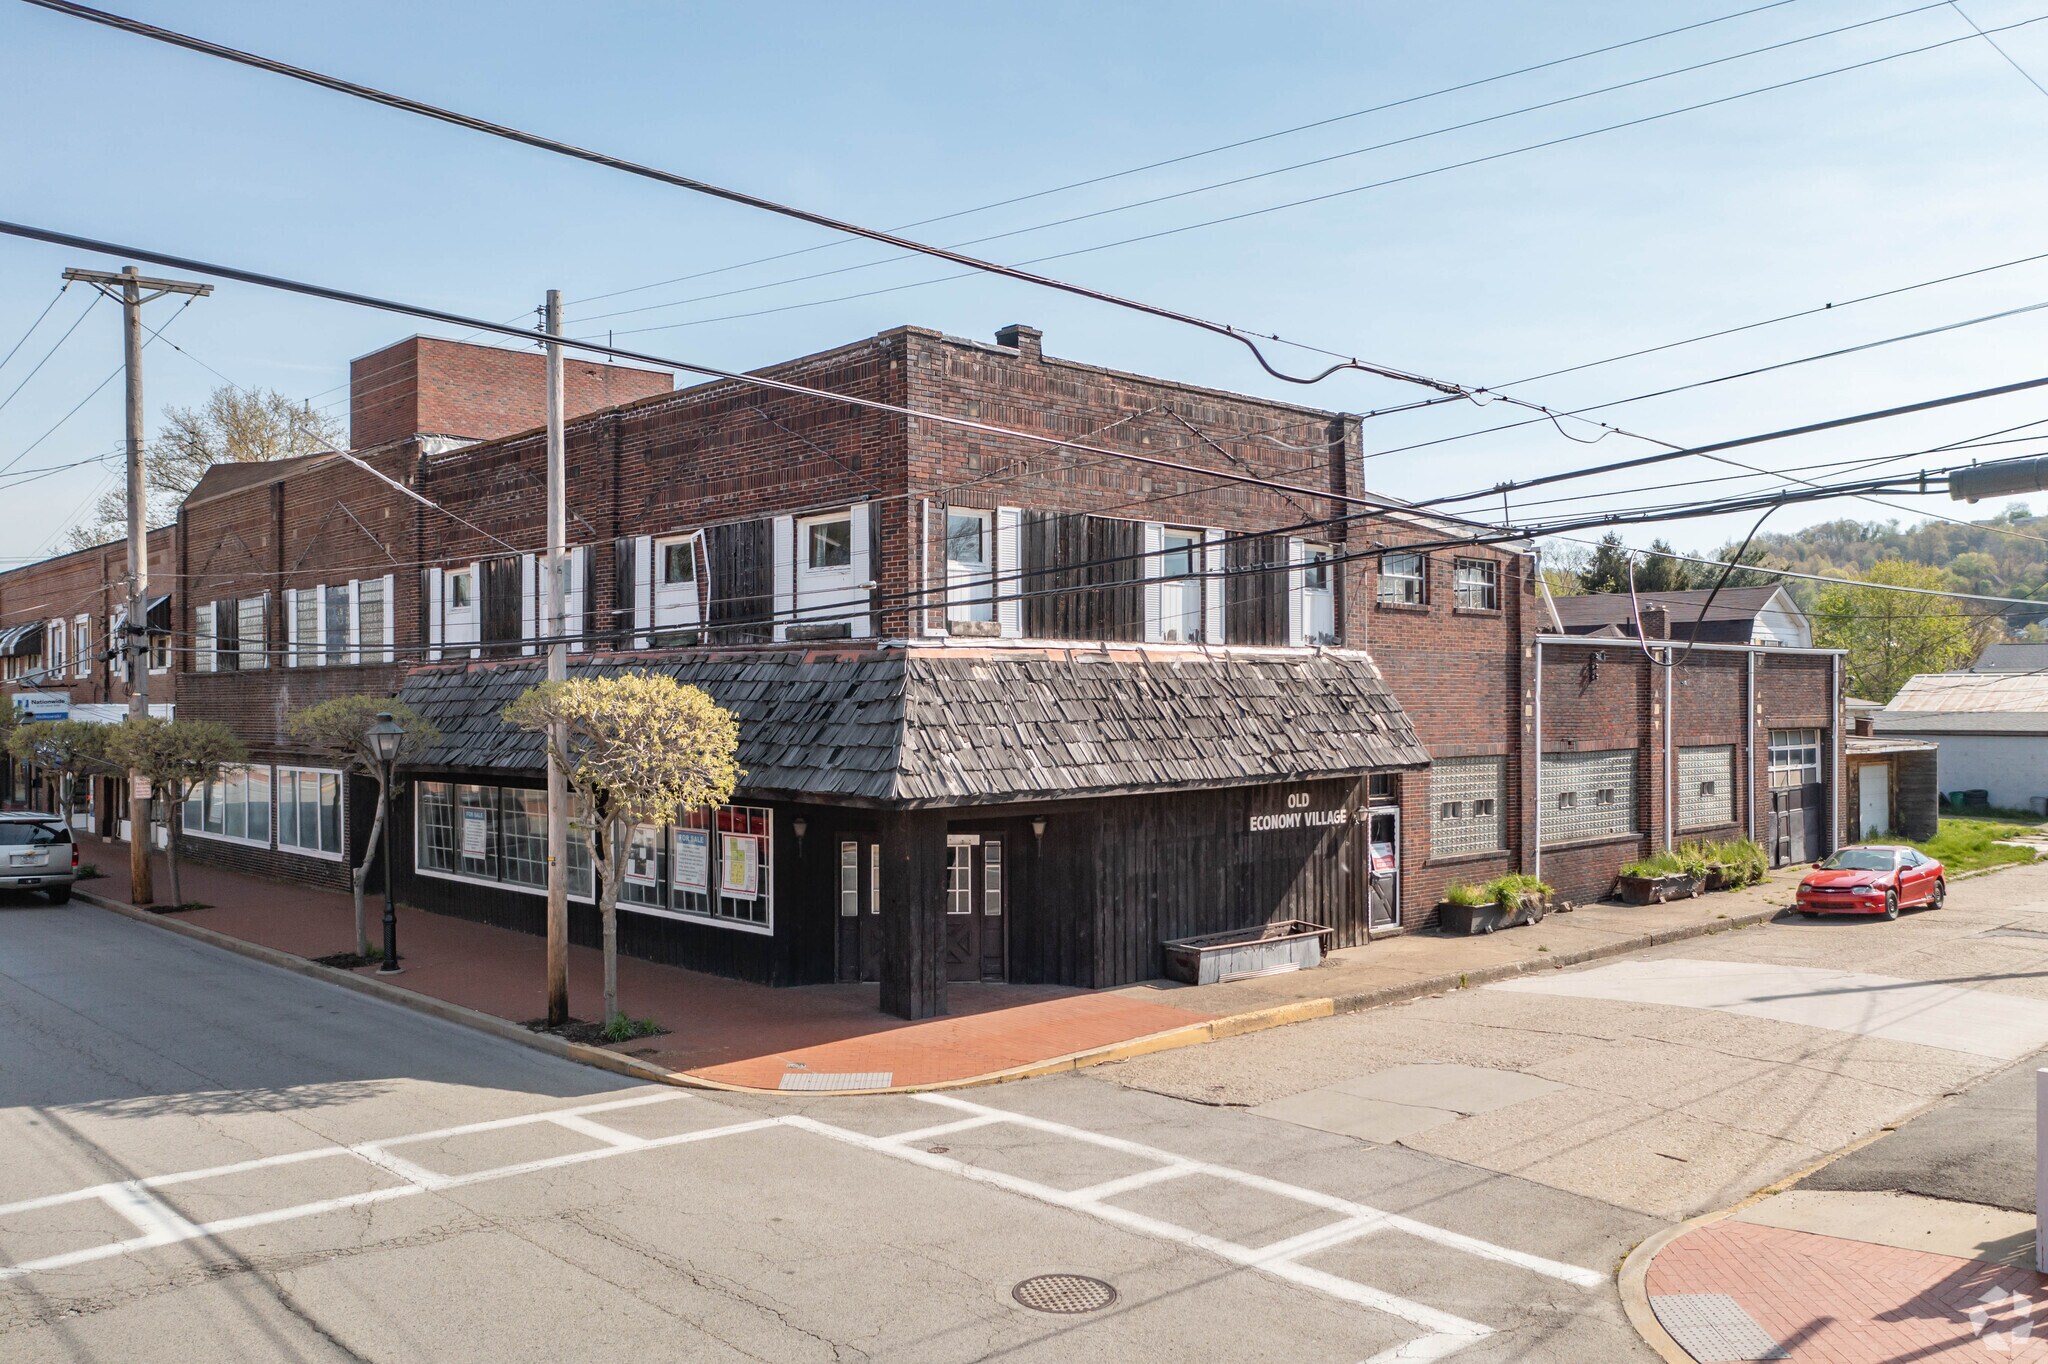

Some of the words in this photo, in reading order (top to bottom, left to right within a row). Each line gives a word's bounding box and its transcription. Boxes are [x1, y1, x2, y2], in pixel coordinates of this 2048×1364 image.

[1288, 793, 1310, 808] OLD
[1250, 813, 1301, 831] ECONOMY
[1304, 809, 1347, 827] VILLAGE
[679, 834, 690, 842] FOR
[690, 835, 704, 843] SALE
